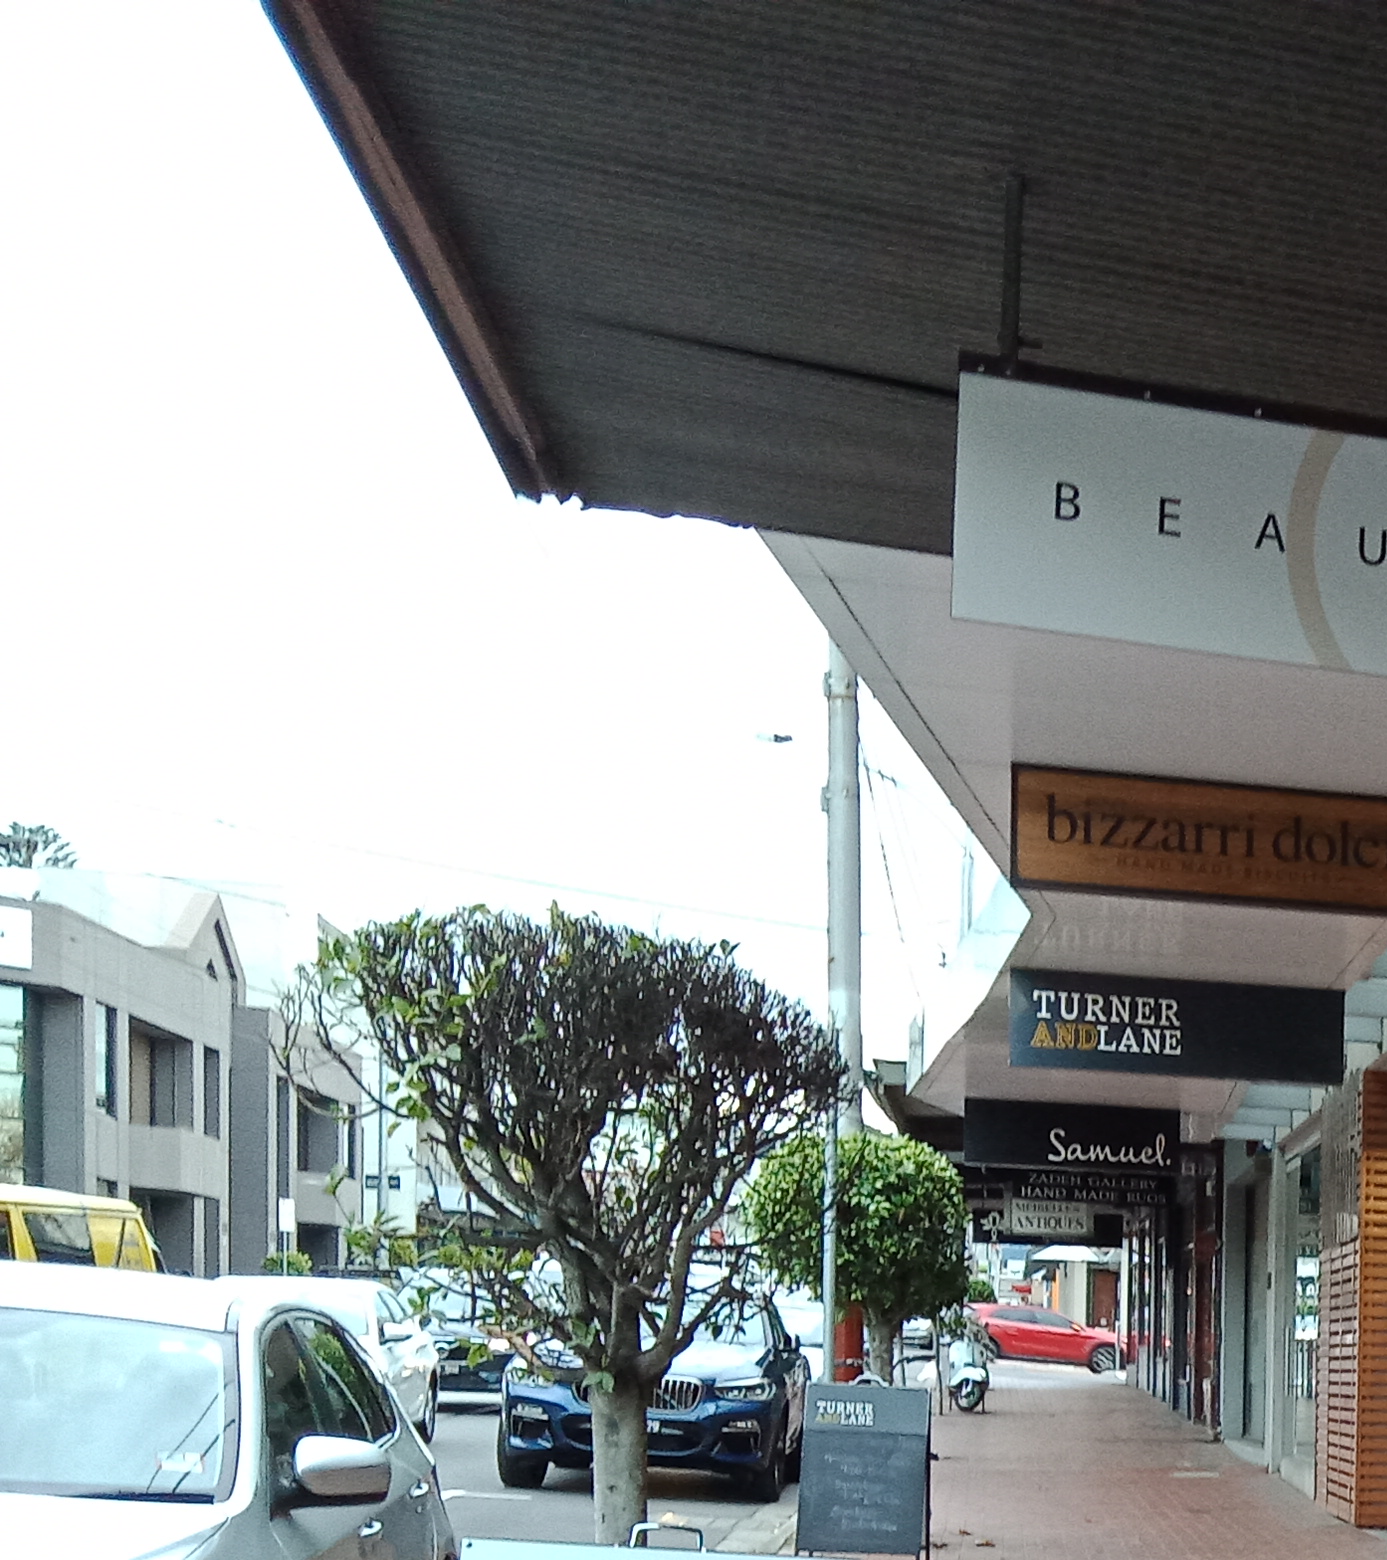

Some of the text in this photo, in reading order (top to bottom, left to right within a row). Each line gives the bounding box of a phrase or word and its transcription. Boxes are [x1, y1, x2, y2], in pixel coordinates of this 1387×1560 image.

[1046, 794, 1254, 857] bizzarri
[1033, 990, 1180, 1028] TURNER
[1087, 1176, 1157, 1190] GALLERY
[1021, 1185, 1066, 1199] HAND
[1074, 1188, 1120, 1201] MADE
[816, 1400, 873, 1417] TURNER
